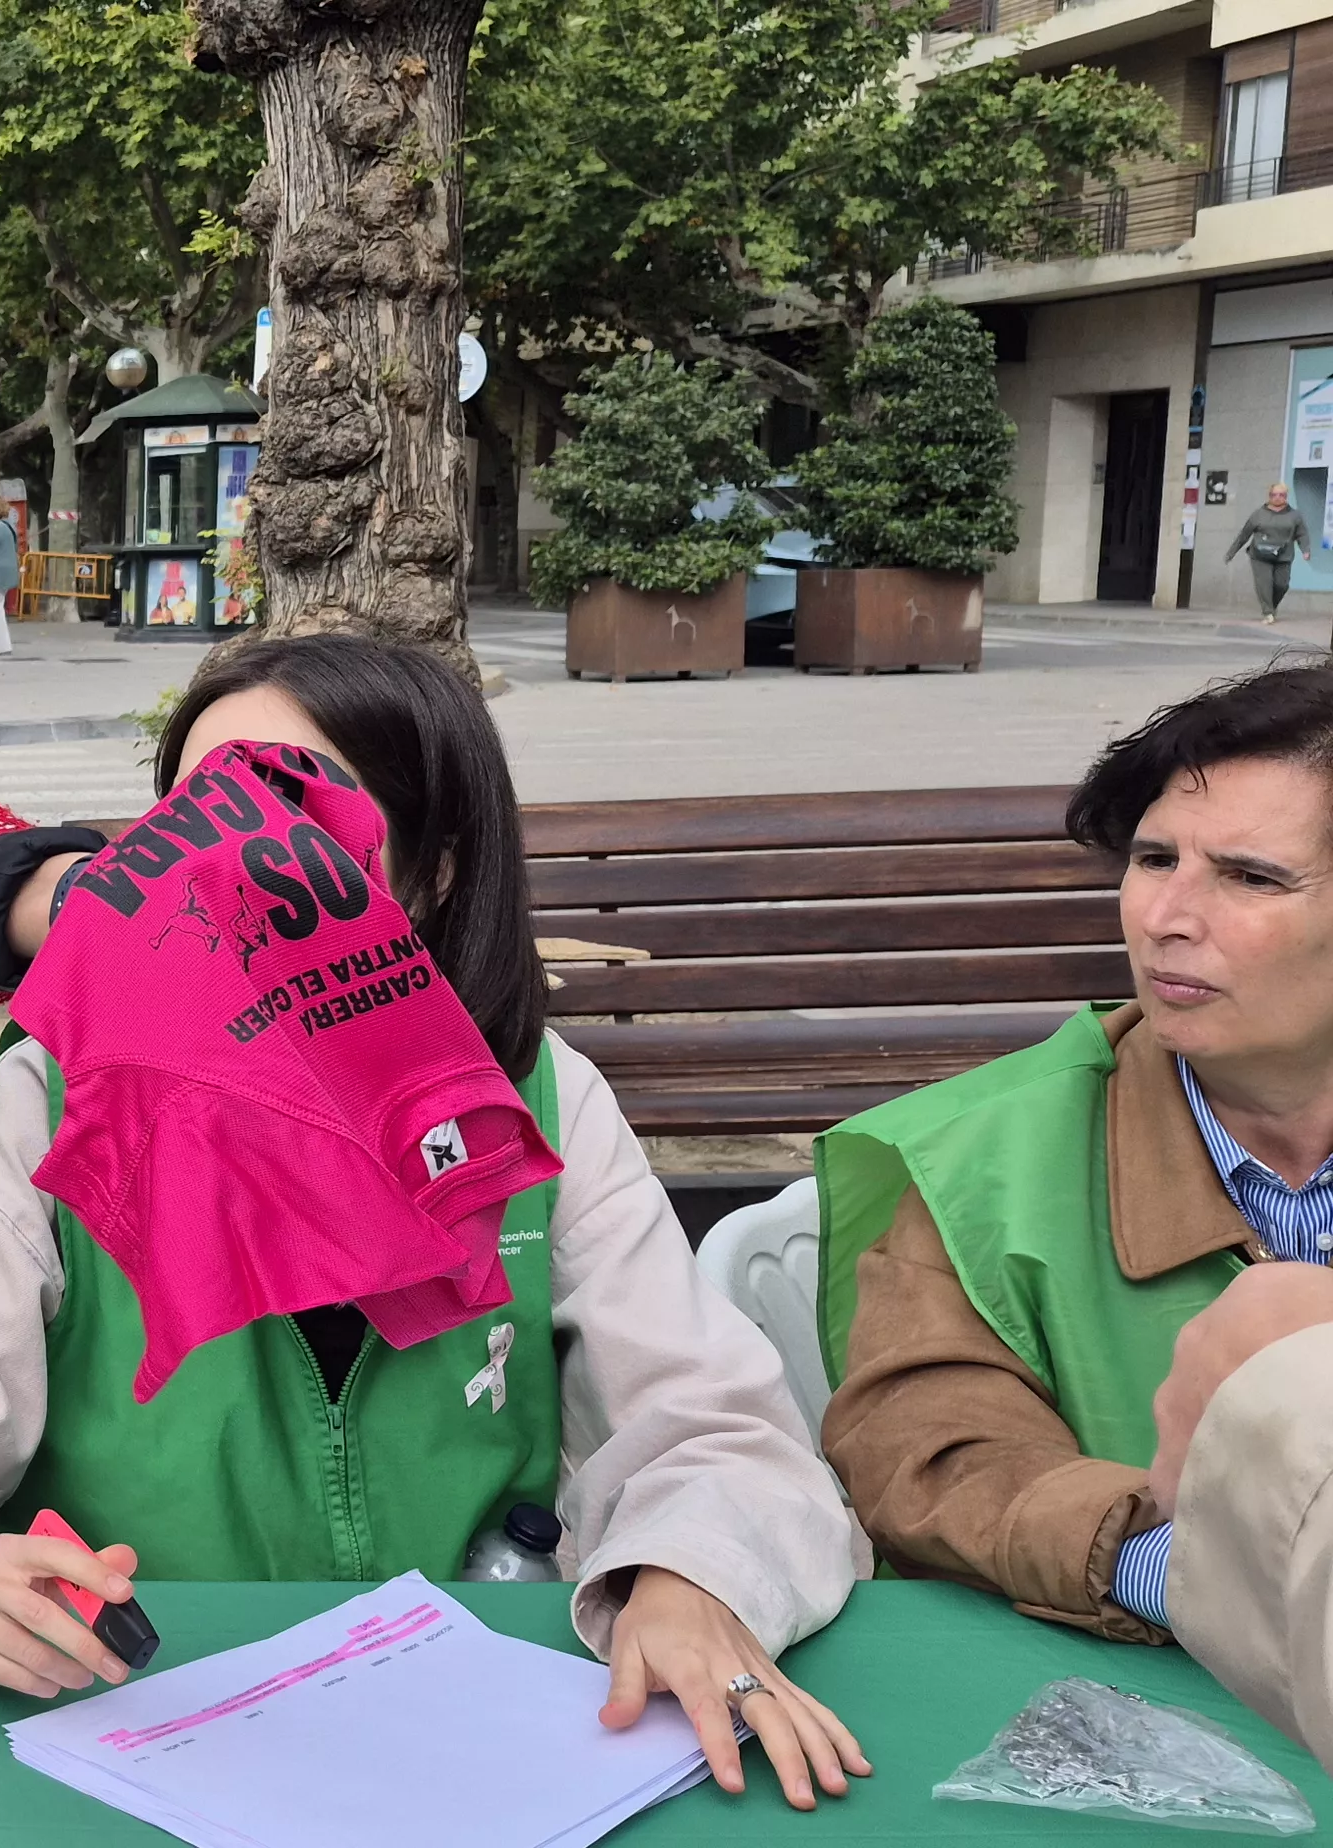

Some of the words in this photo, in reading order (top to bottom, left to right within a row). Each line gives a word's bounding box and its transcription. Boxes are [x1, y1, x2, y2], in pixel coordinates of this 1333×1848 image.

[287, 969, 328, 1001] EL
[298, 965, 432, 1038] CARRERA
[499, 1229, 544, 1245] spañola
[498, 1246, 522, 1257] ncer
